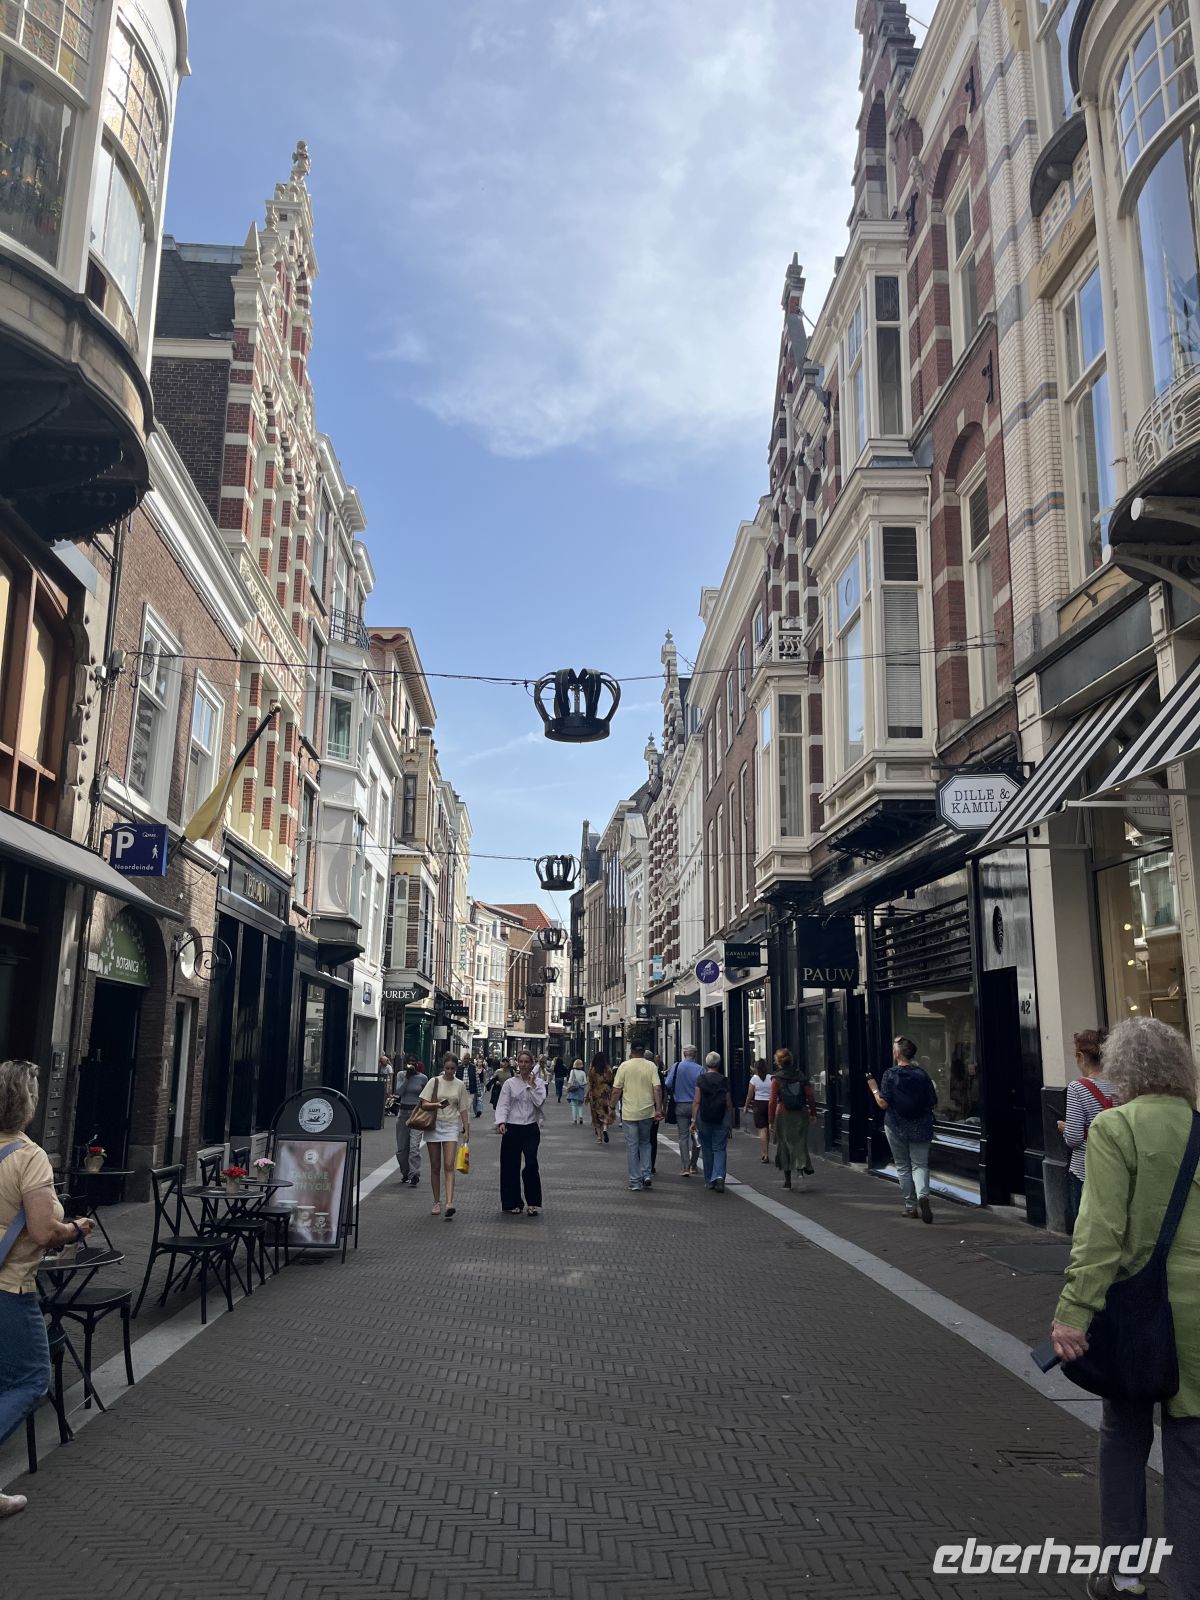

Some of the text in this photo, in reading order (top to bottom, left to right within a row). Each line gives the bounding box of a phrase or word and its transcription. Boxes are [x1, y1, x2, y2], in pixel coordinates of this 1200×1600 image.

[954, 787, 1011, 802] DILLE &
[115, 831, 135, 859] P
[114, 863, 154, 871] Noordeinde
[802, 967, 855, 982] PAUW
[1020, 1000, 1031, 1015] 42
